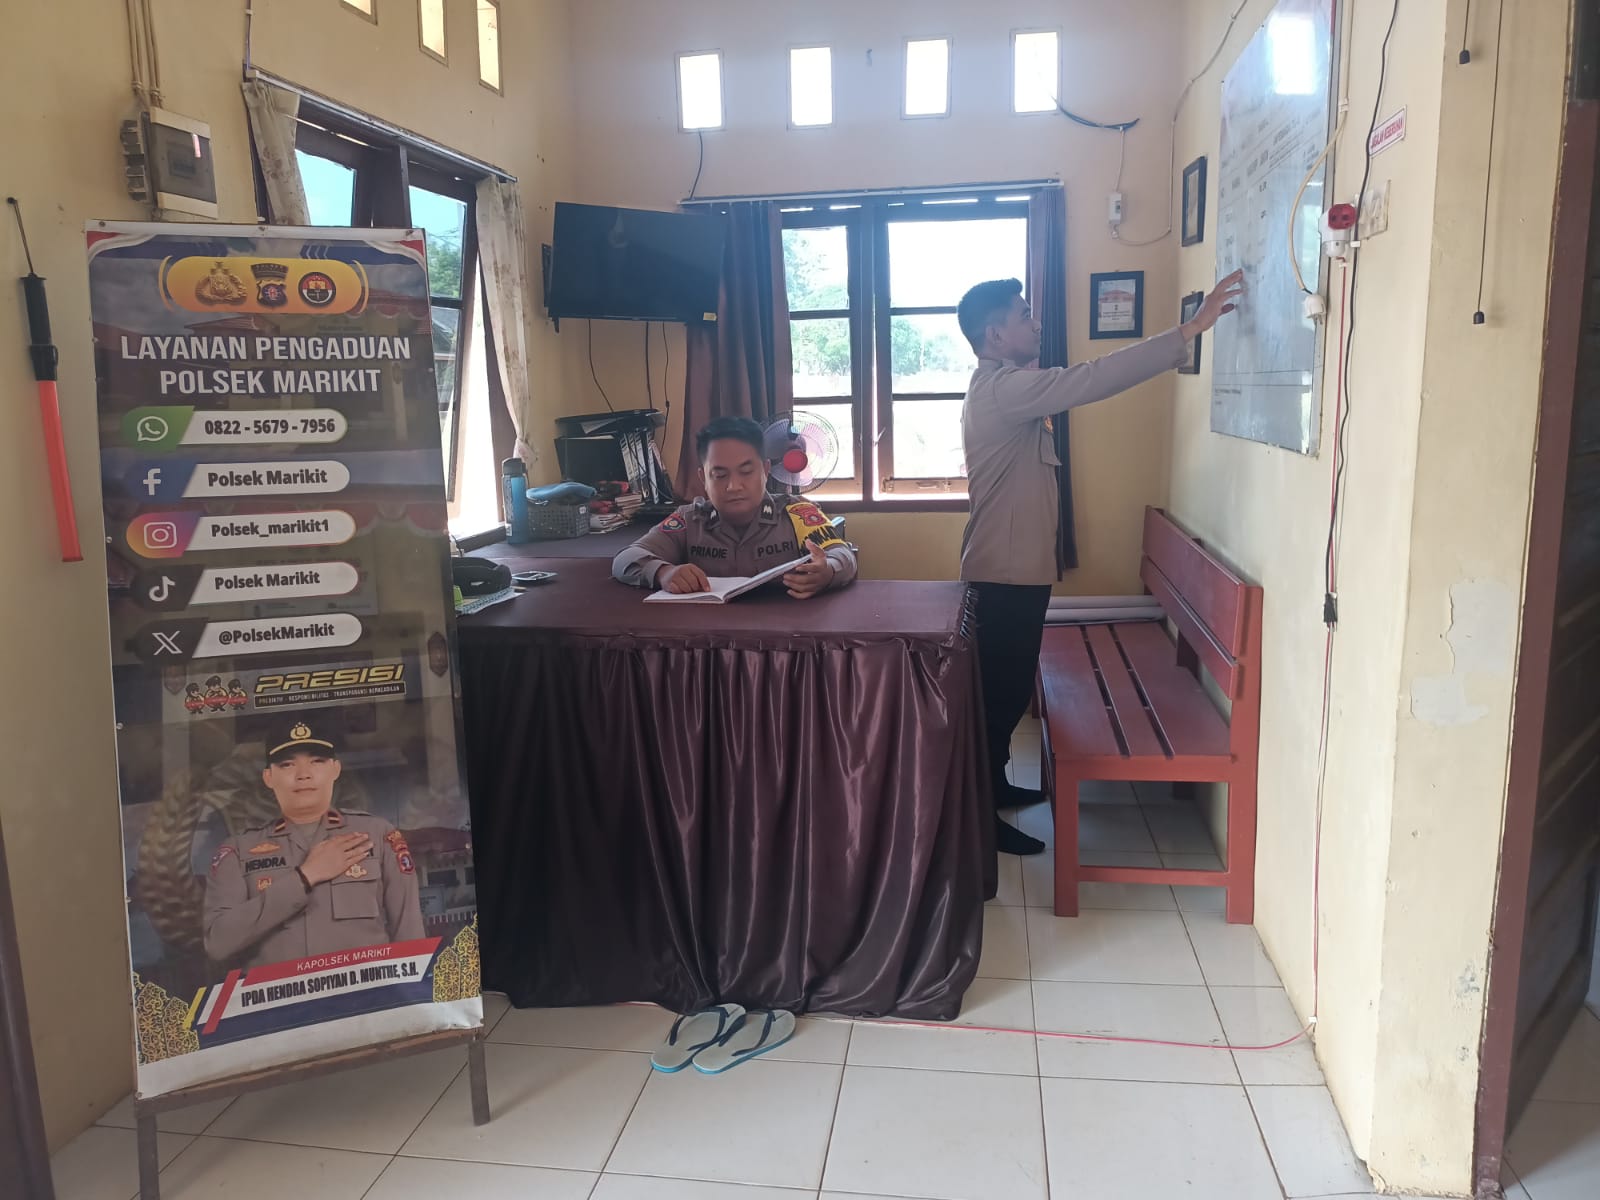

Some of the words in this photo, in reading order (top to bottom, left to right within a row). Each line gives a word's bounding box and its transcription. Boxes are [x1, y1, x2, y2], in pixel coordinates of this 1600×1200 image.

[121, 336, 247, 360] LAYANAN
[255, 336, 411, 360] PENGADUAN
[160, 369, 267, 394] POLSEK
[273, 369, 381, 393] MARIKIT
[204, 420, 242, 435] 0822
[253, 419, 289, 434] 5679
[300, 418, 336, 433] 7956
[208, 470, 264, 487] Polsek
[266, 468, 328, 485] Marikit
[211, 518, 329, 538] Polsek_marikit1
[690, 545, 728, 559] PRIADIE
[757, 540, 794, 557] POLRI
[214, 573, 264, 590] Polsek
[266, 571, 321, 587] Marikit
[218, 622, 335, 645] @PolsekMarikit
[254, 663, 405, 693] PRESISI
[245, 856, 287, 873] HENDRA
[297, 953, 350, 972] KAPOLSEK
[352, 947, 392, 961] MARIKIT
[241, 988, 266, 1008] IPDA
[267, 981, 306, 1002] HENDRA
[307, 972, 348, 994] SOPIYAN
[349, 970, 359, 985] D.
[360, 964, 401, 984] MUNTHE,
[401, 961, 419, 978] S.H.
